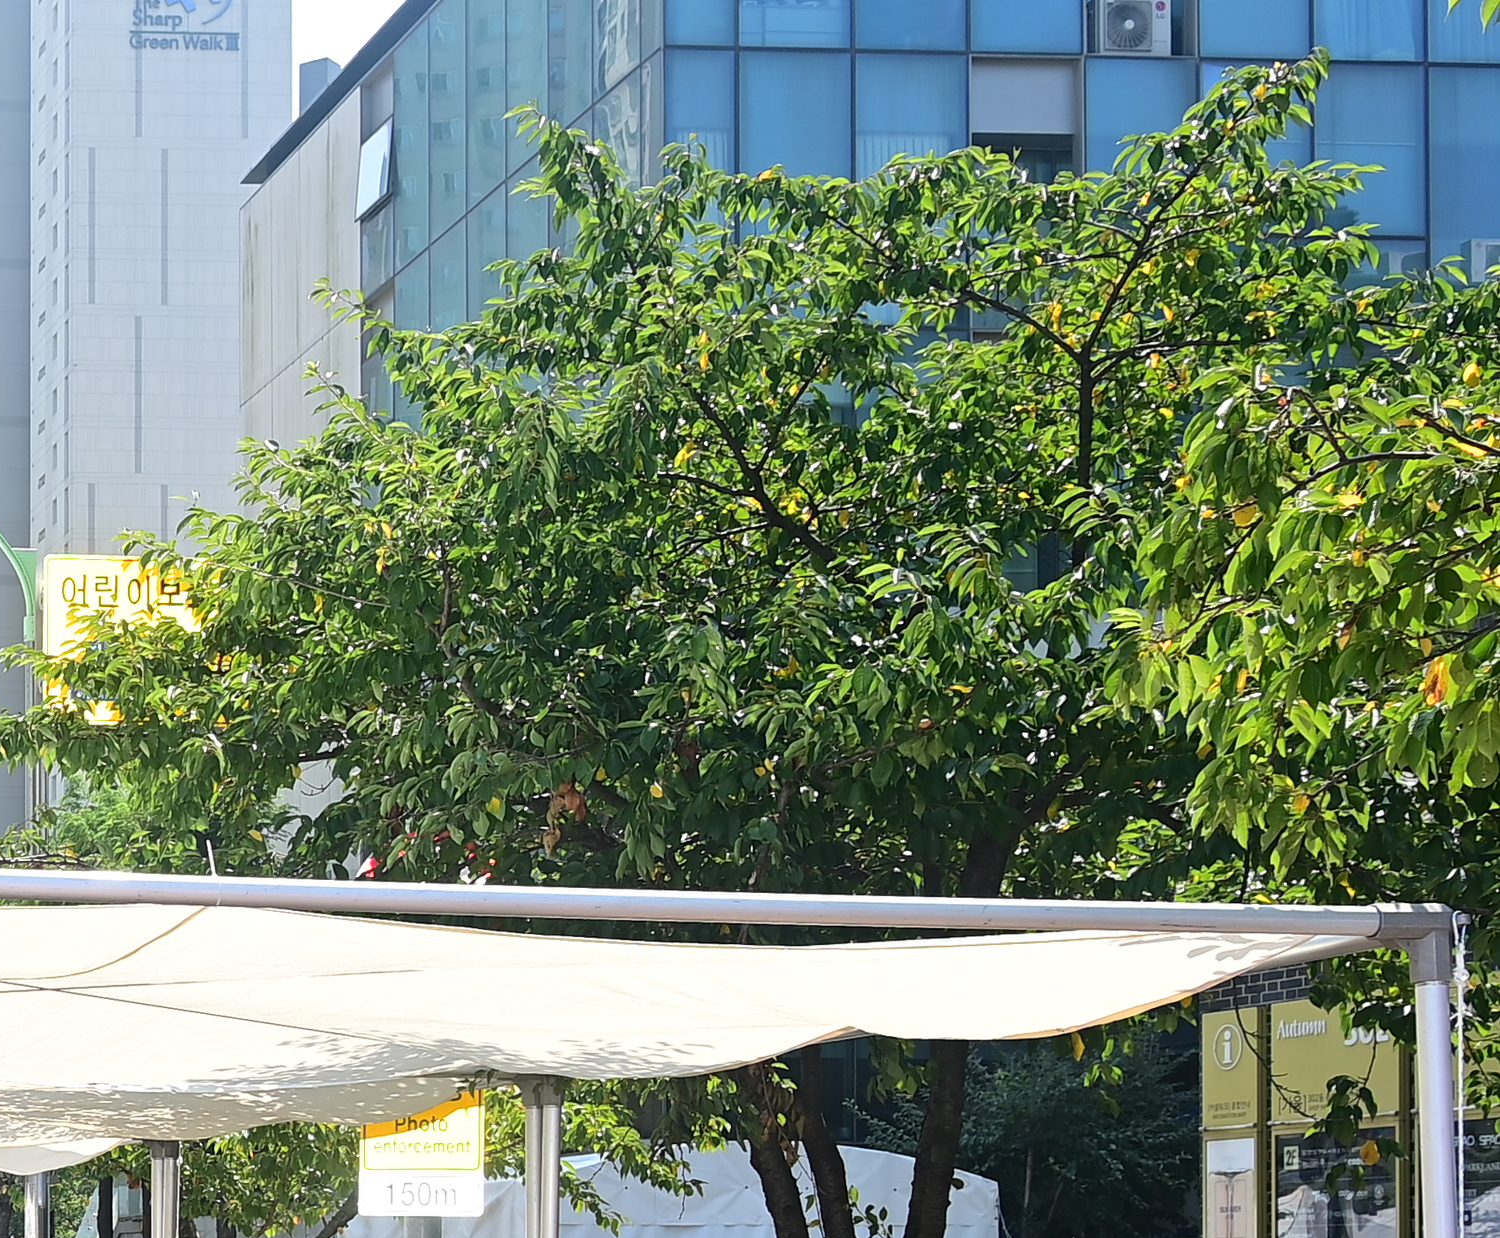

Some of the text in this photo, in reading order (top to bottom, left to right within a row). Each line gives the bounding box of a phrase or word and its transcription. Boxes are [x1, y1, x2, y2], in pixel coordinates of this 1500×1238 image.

[132, 9, 183, 31] Sharp
[129, 34, 180, 50] Green
[183, 35, 224, 51] Walk
[61, 573, 190, 608] 어린이보
[1276, 1018, 1327, 1041] Autumn
[394, 1115, 448, 1132] Photo
[373, 1139, 471, 1153] enforcement
[1284, 1148, 1297, 1168] 2F
[386, 1182, 457, 1206] 150m
